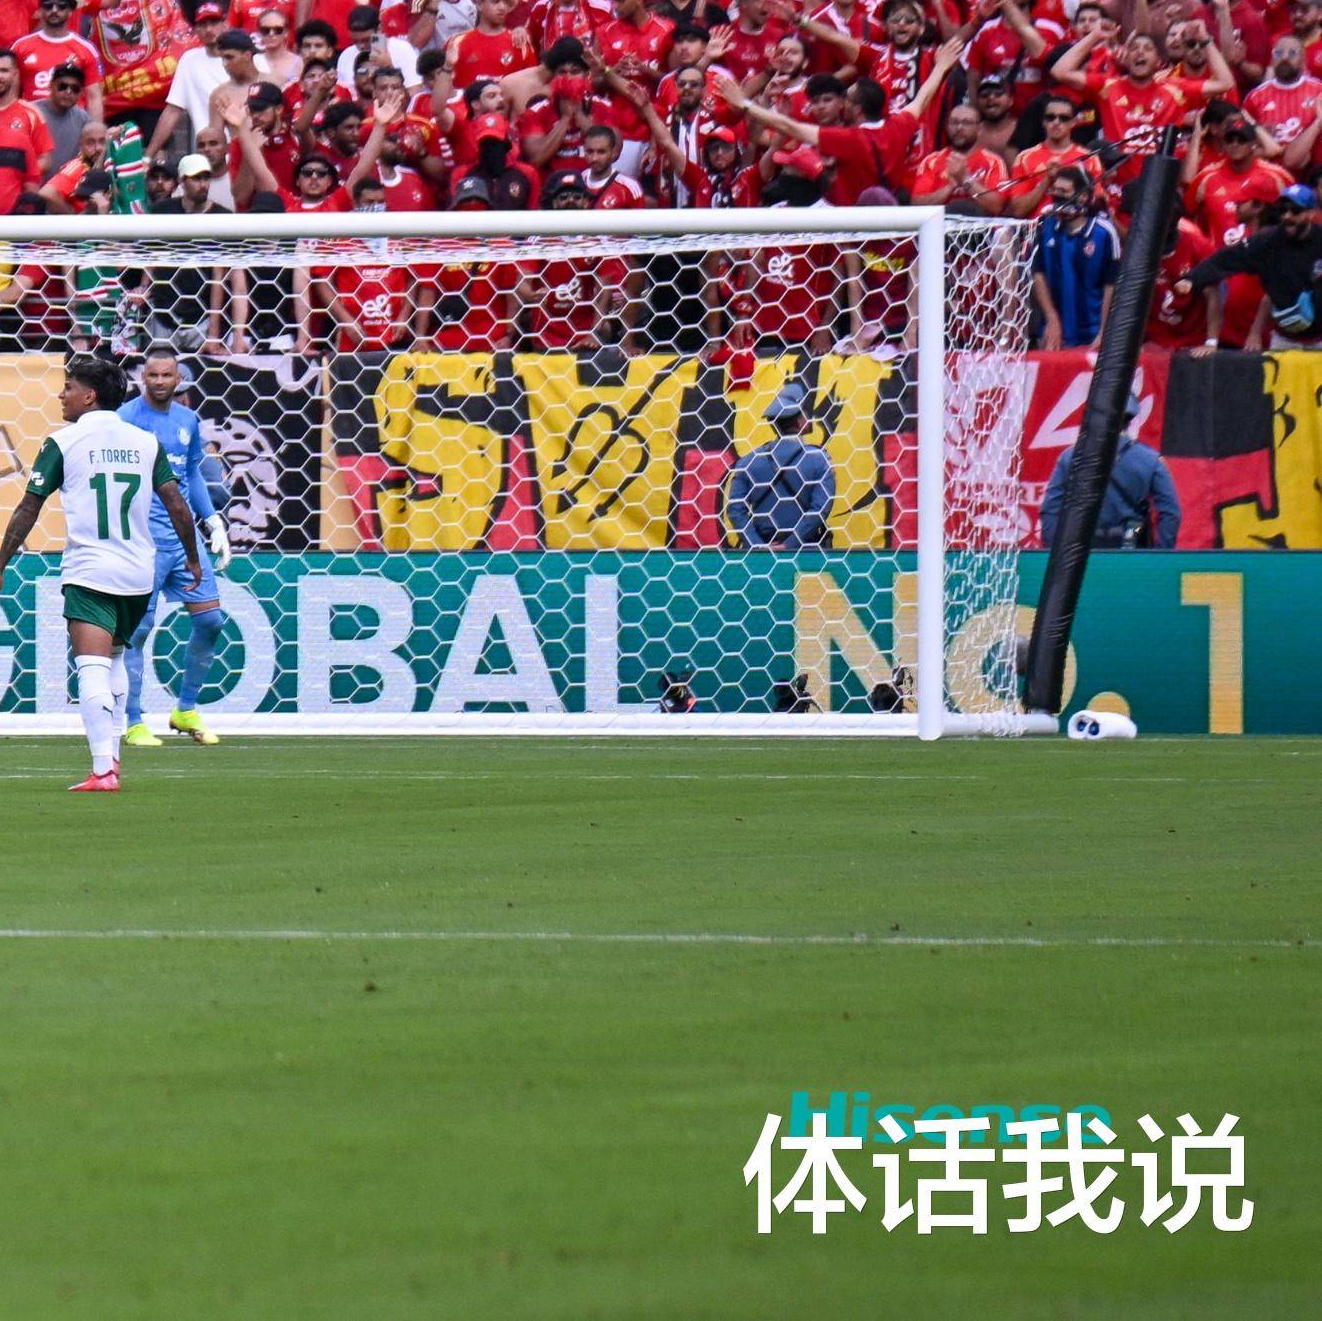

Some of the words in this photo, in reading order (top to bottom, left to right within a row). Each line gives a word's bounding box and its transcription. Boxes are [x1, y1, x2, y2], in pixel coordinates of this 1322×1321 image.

[102, 449, 141, 465] TORRES
[90, 473, 141, 541] 17
[1180, 571, 1244, 734] 1
